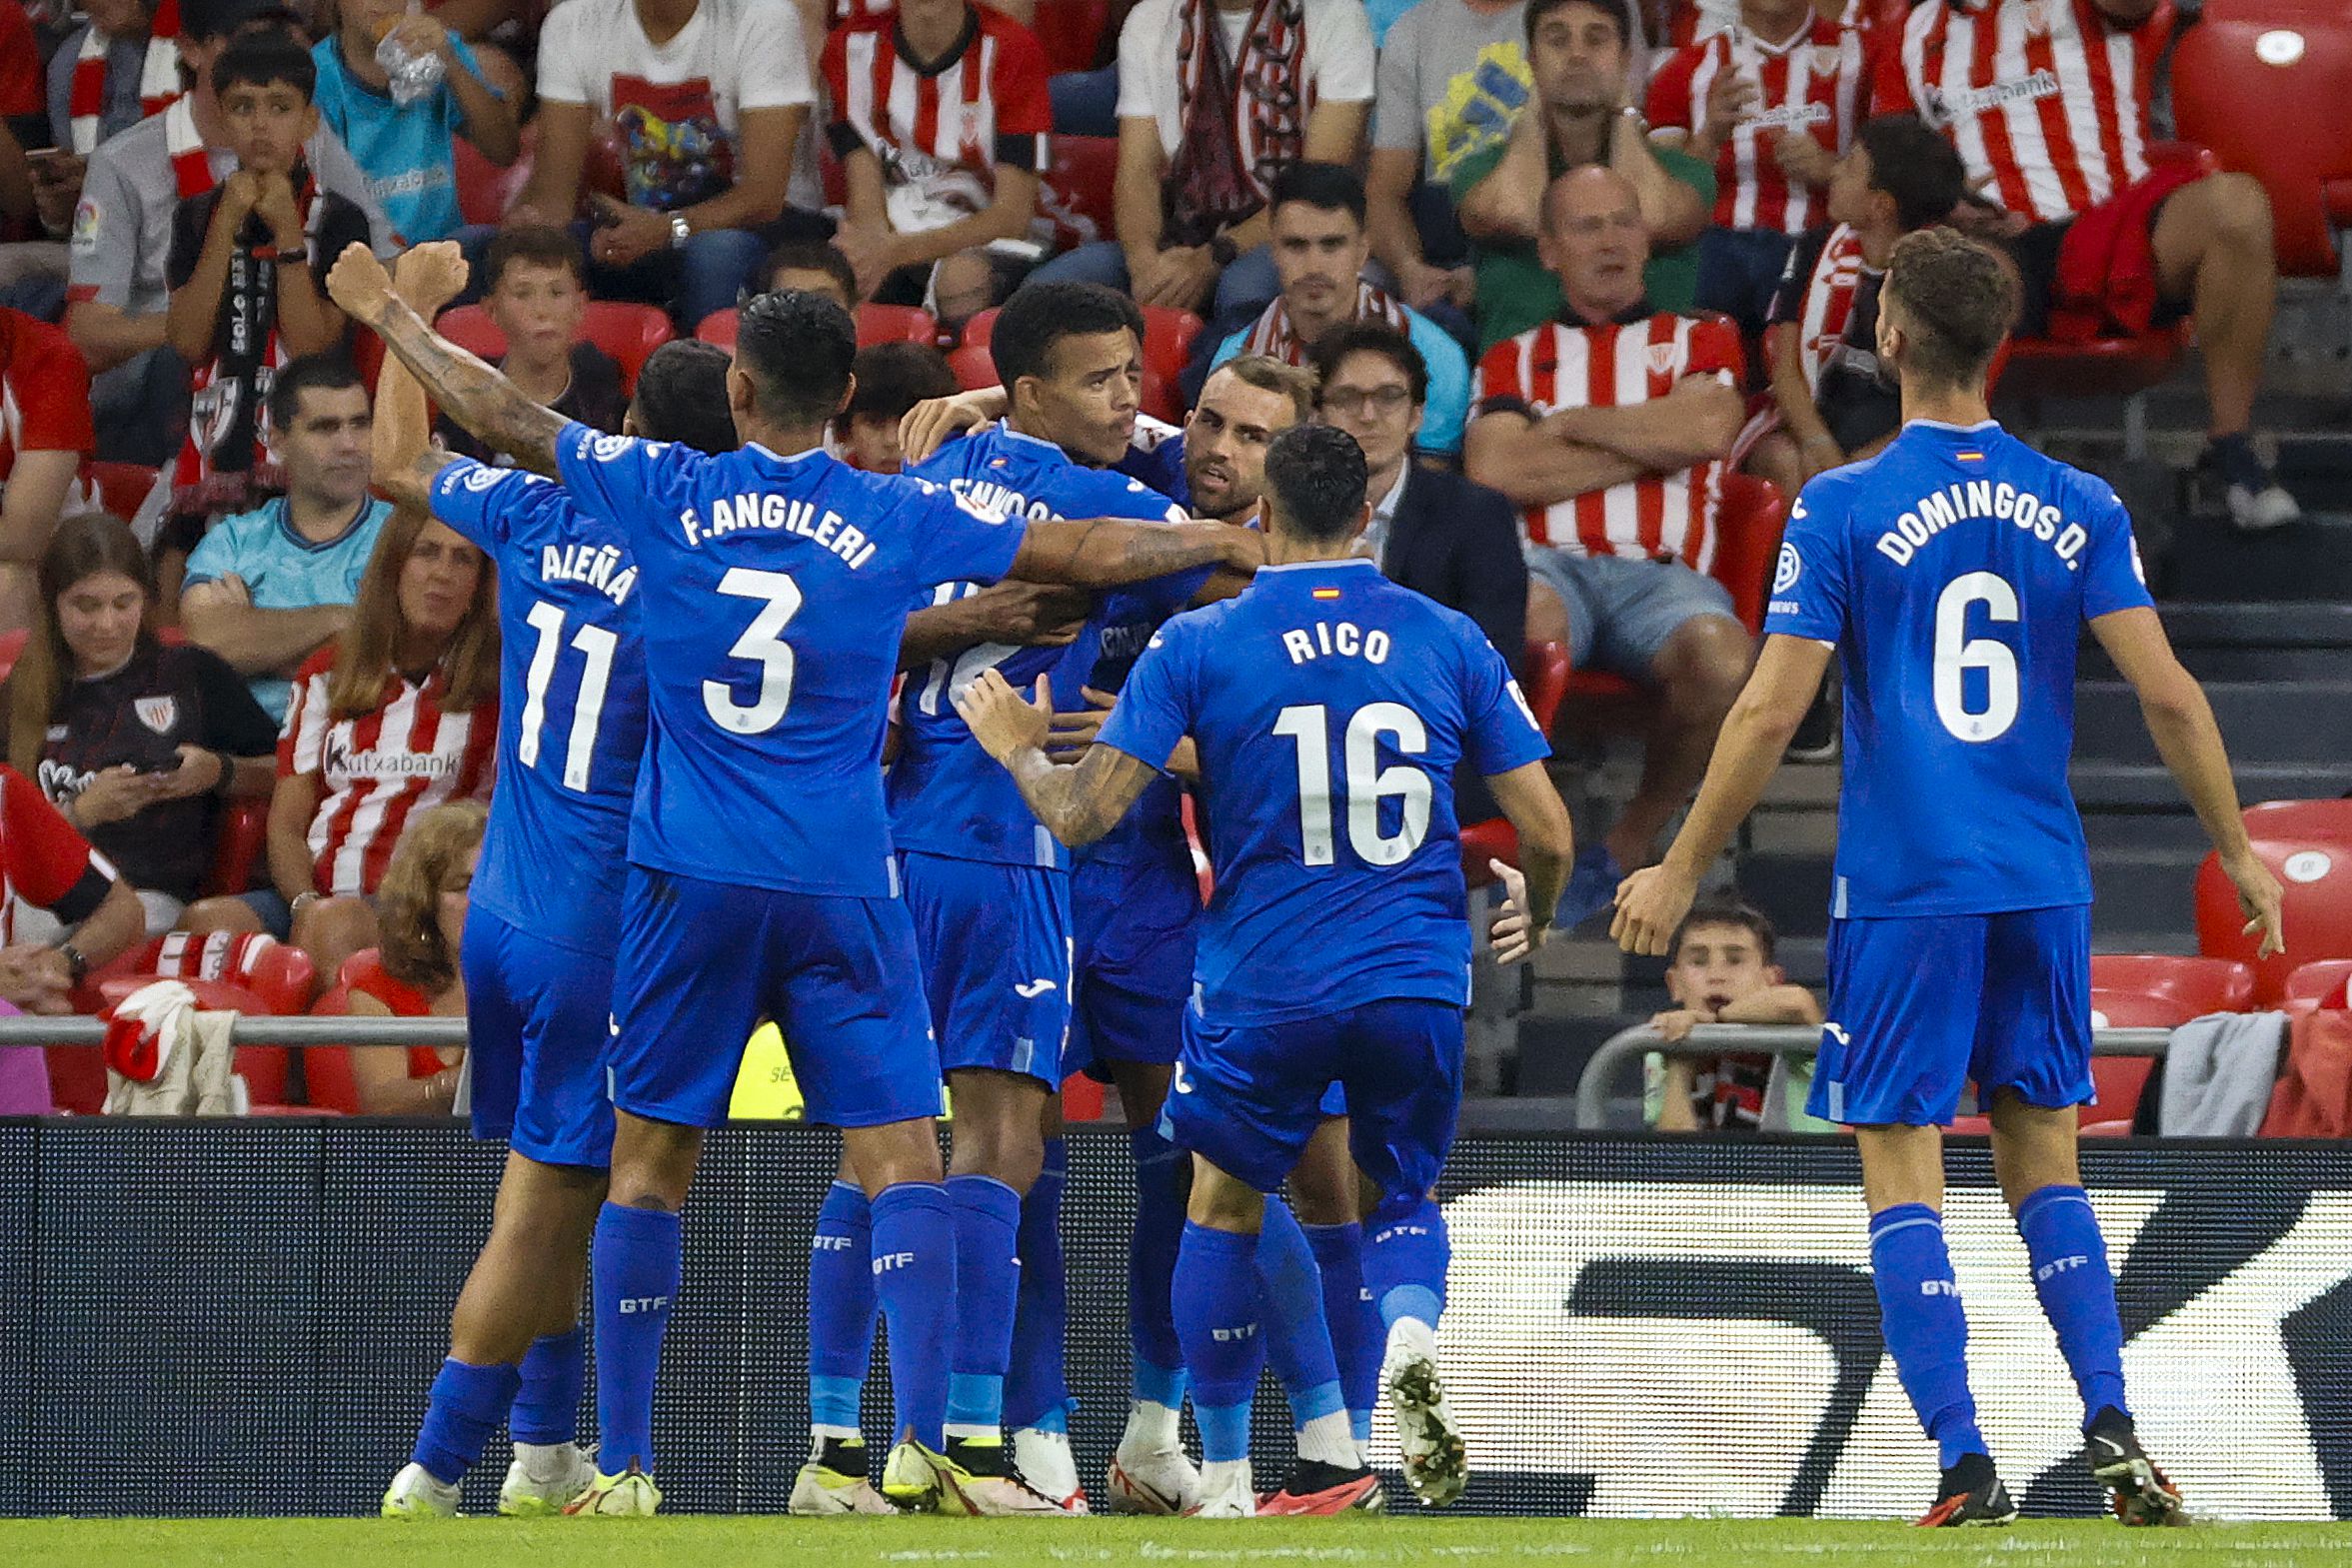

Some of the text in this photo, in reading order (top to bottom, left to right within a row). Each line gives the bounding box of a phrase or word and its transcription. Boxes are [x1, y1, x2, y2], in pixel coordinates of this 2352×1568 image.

[680, 493, 877, 570] F.ANGILERI
[1875, 480, 2061, 568] DOMINGOS
[542, 545, 639, 606] ALEÑÁ
[702, 567, 803, 735] 3
[1282, 622, 1390, 665] RICO
[1933, 571, 2019, 743] 6
[519, 601, 618, 792] 11
[325, 732, 462, 776] Kutxabank
[1271, 702, 1432, 866] 16
[620, 1296, 668, 1314] GTF
